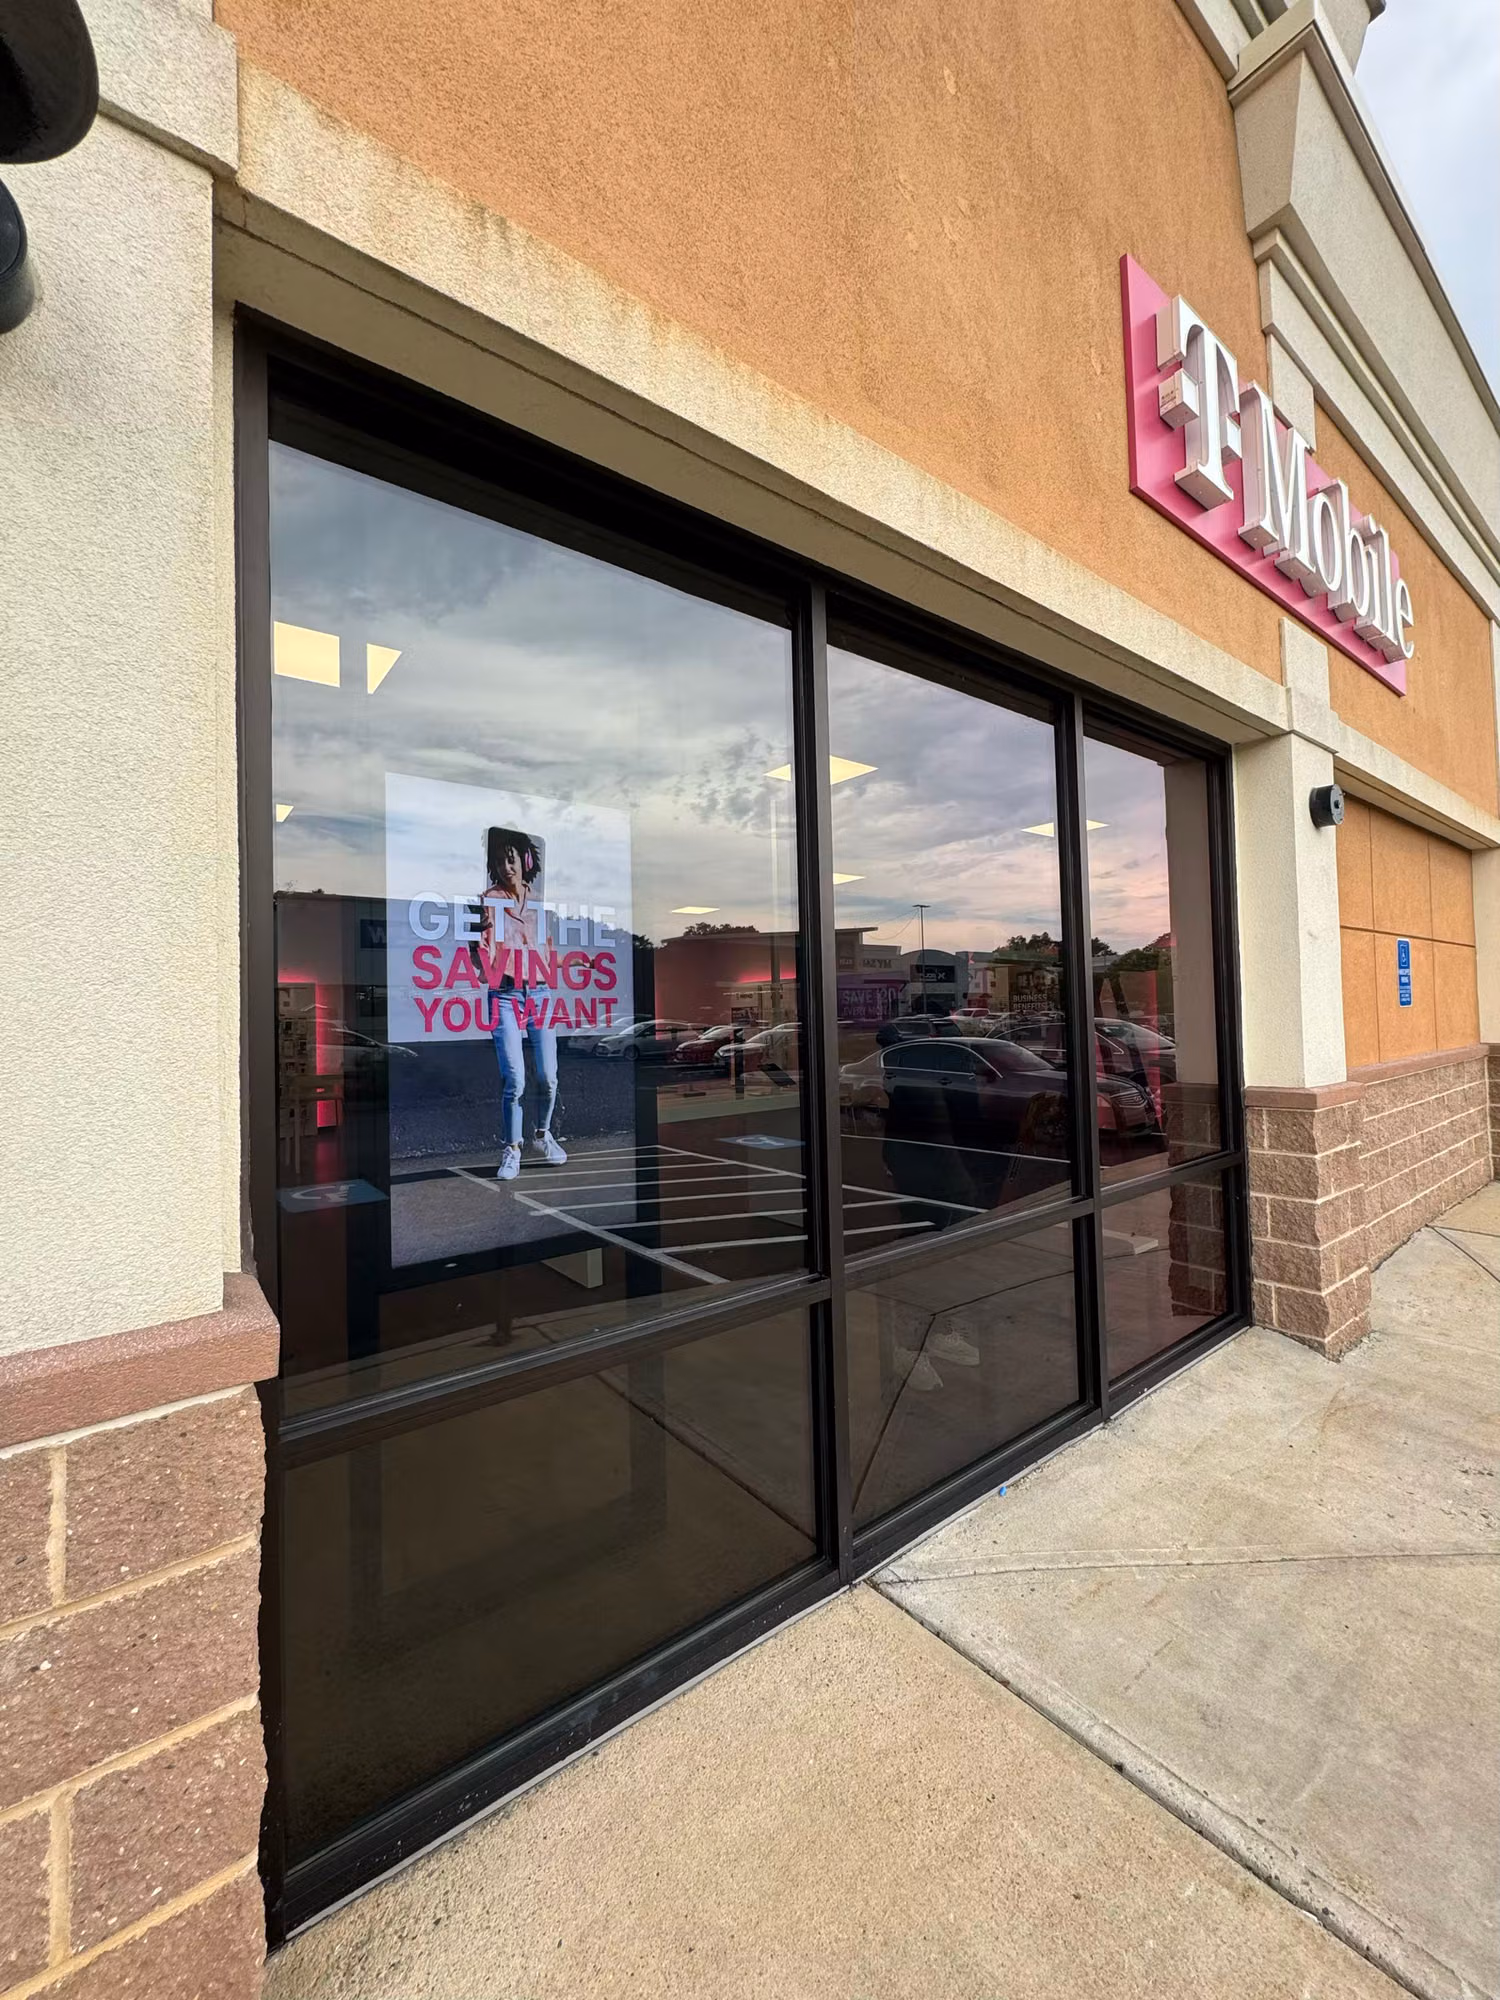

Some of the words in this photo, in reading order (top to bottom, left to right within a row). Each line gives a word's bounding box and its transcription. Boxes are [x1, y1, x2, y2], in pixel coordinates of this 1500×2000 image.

[408, 891, 514, 942] GET
[526, 900, 616, 948] THE
[412, 945, 618, 991] SAVINGS
[413, 997, 500, 1033] YOU
[511, 997, 618, 1031] WANT
[1012, 993, 1048, 1003] BUSINESS
